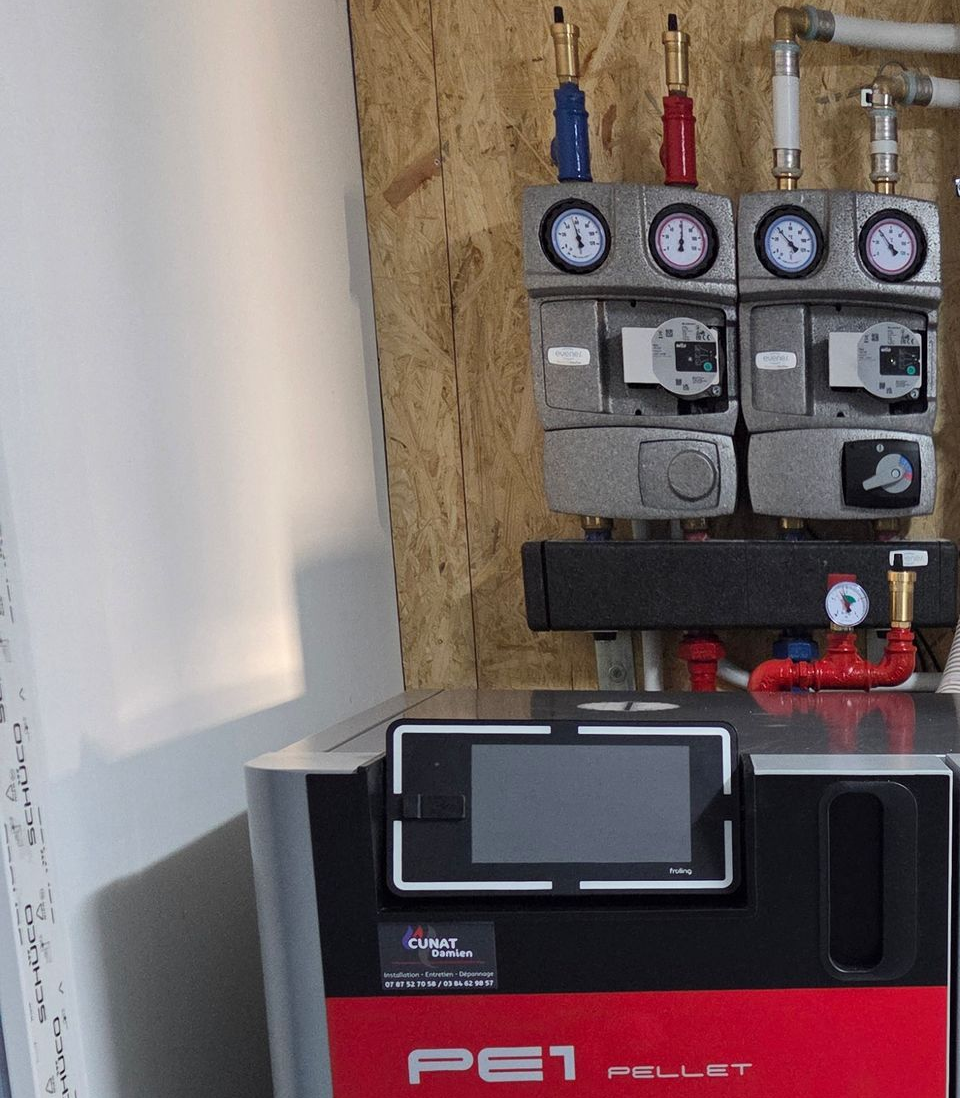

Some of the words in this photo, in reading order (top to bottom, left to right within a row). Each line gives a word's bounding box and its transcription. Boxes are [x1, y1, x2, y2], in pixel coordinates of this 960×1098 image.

[13, 722, 36, 845] SCHÜCO
[408, 938, 458, 949] CUNAT
[431, 949, 473, 957] Damien
[24, 904, 47, 1023] SCHÜCO
[407, 1045, 576, 1084] PE1
[607, 1063, 753, 1080] PELLET
